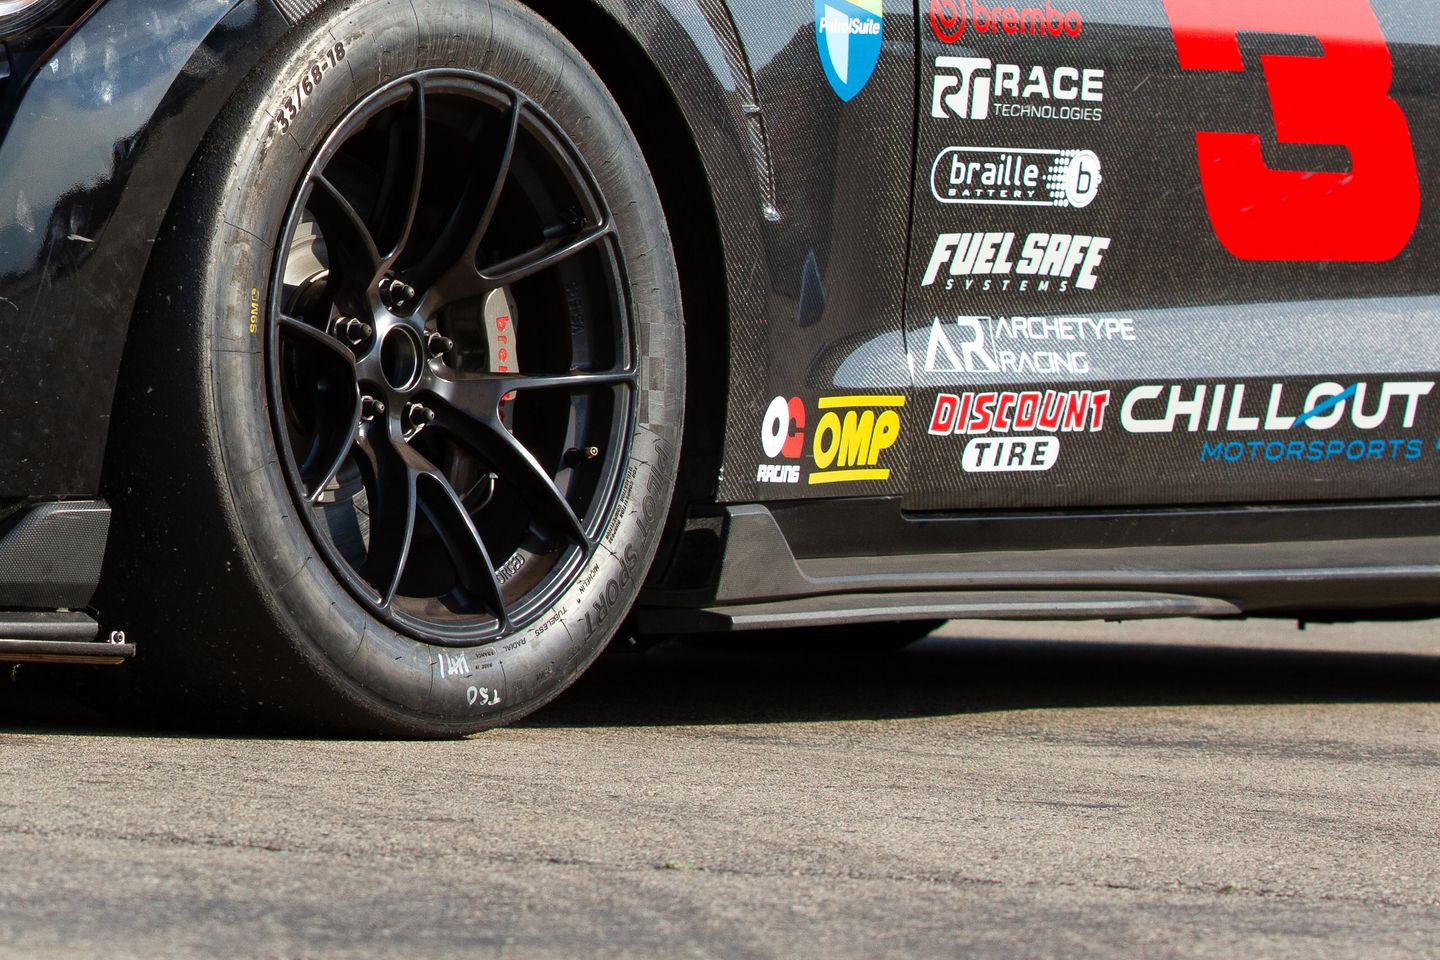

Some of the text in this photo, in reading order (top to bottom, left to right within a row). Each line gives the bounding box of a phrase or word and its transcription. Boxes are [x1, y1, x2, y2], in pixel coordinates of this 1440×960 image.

[819, 17, 881, 36] PatrolSuite
[994, 63, 1105, 102] RACE
[993, 103, 1103, 121] TECHNOLOGIES
[949, 154, 1039, 187] braille
[947, 188, 1036, 198] BATTERY
[921, 232, 1111, 290] FUEL SAFE
[945, 278, 1068, 291] SYSTEMS
[996, 316, 1136, 340] ARCHETYPE
[1000, 351, 1089, 374] RACING
[928, 390, 1111, 436] DISCOUNT
[1120, 381, 1436, 433] CHILLOUT
[813, 410, 901, 469] OMP
[1200, 439, 1424, 462] MOTORSPORTS
[974, 441, 1050, 467] TIRE
[756, 463, 800, 483] RACING
[579, 563, 600, 594] MICHELIN
[584, 543, 638, 643] SPORT
[502, 606, 567, 652] TUBELESS RADIAL
